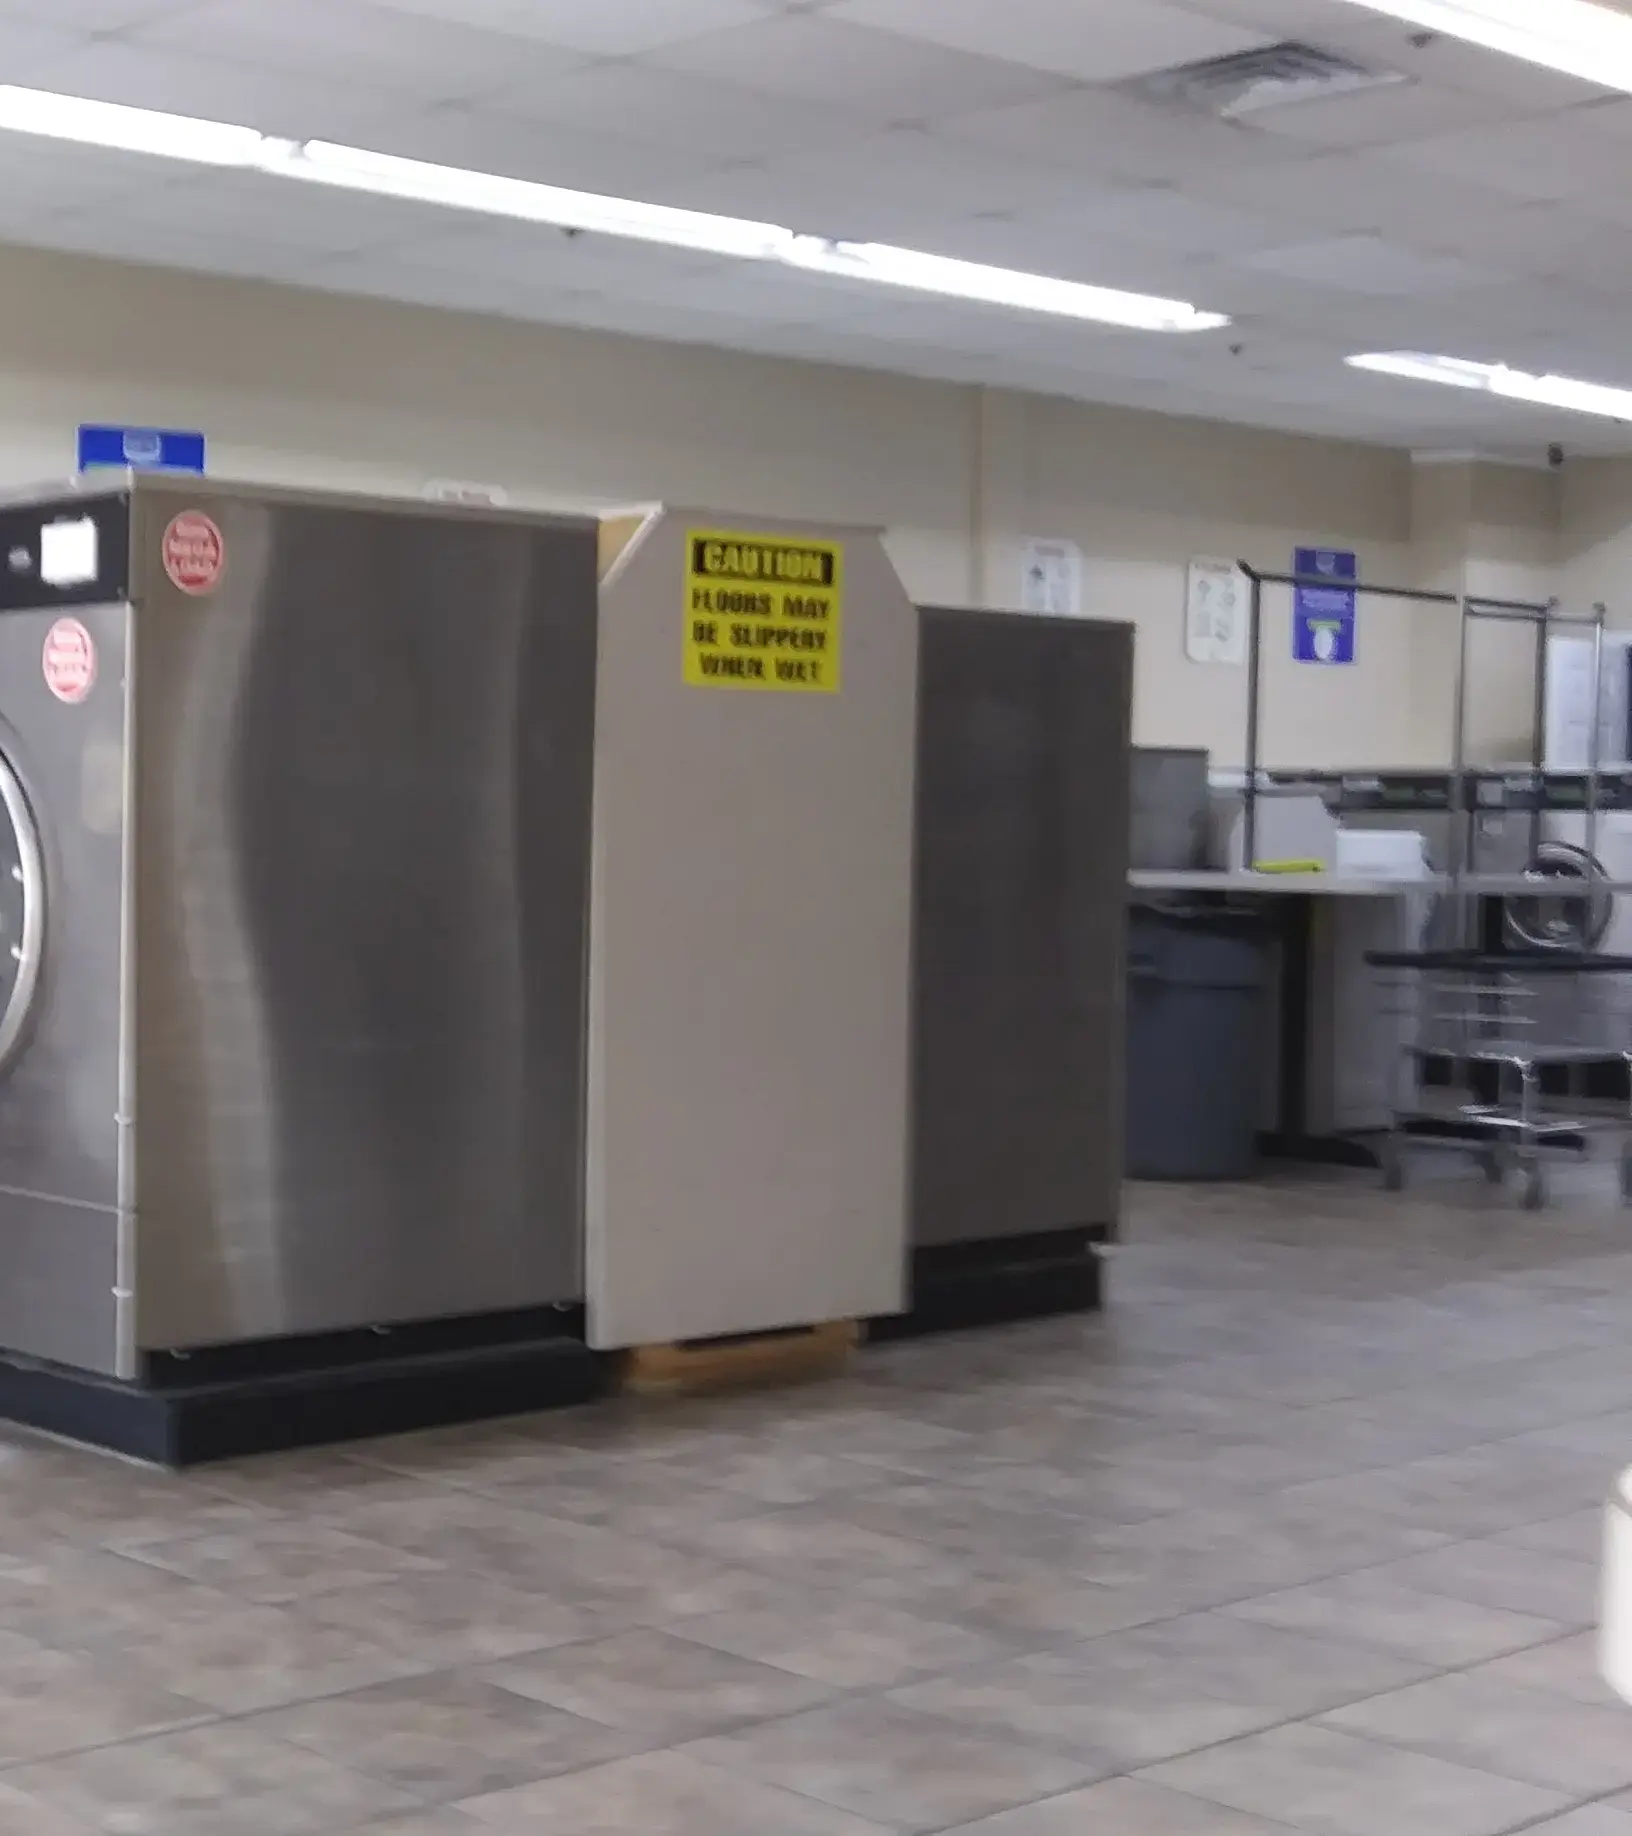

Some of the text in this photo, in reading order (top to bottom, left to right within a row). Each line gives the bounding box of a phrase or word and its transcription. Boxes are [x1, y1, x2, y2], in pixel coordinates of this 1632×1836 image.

[703, 542, 824, 579] CAUTION
[691, 588, 830, 619] FLOORS MAY
[692, 620, 827, 651] BE SLIPPERY
[700, 652, 822, 682] WHEN WET
